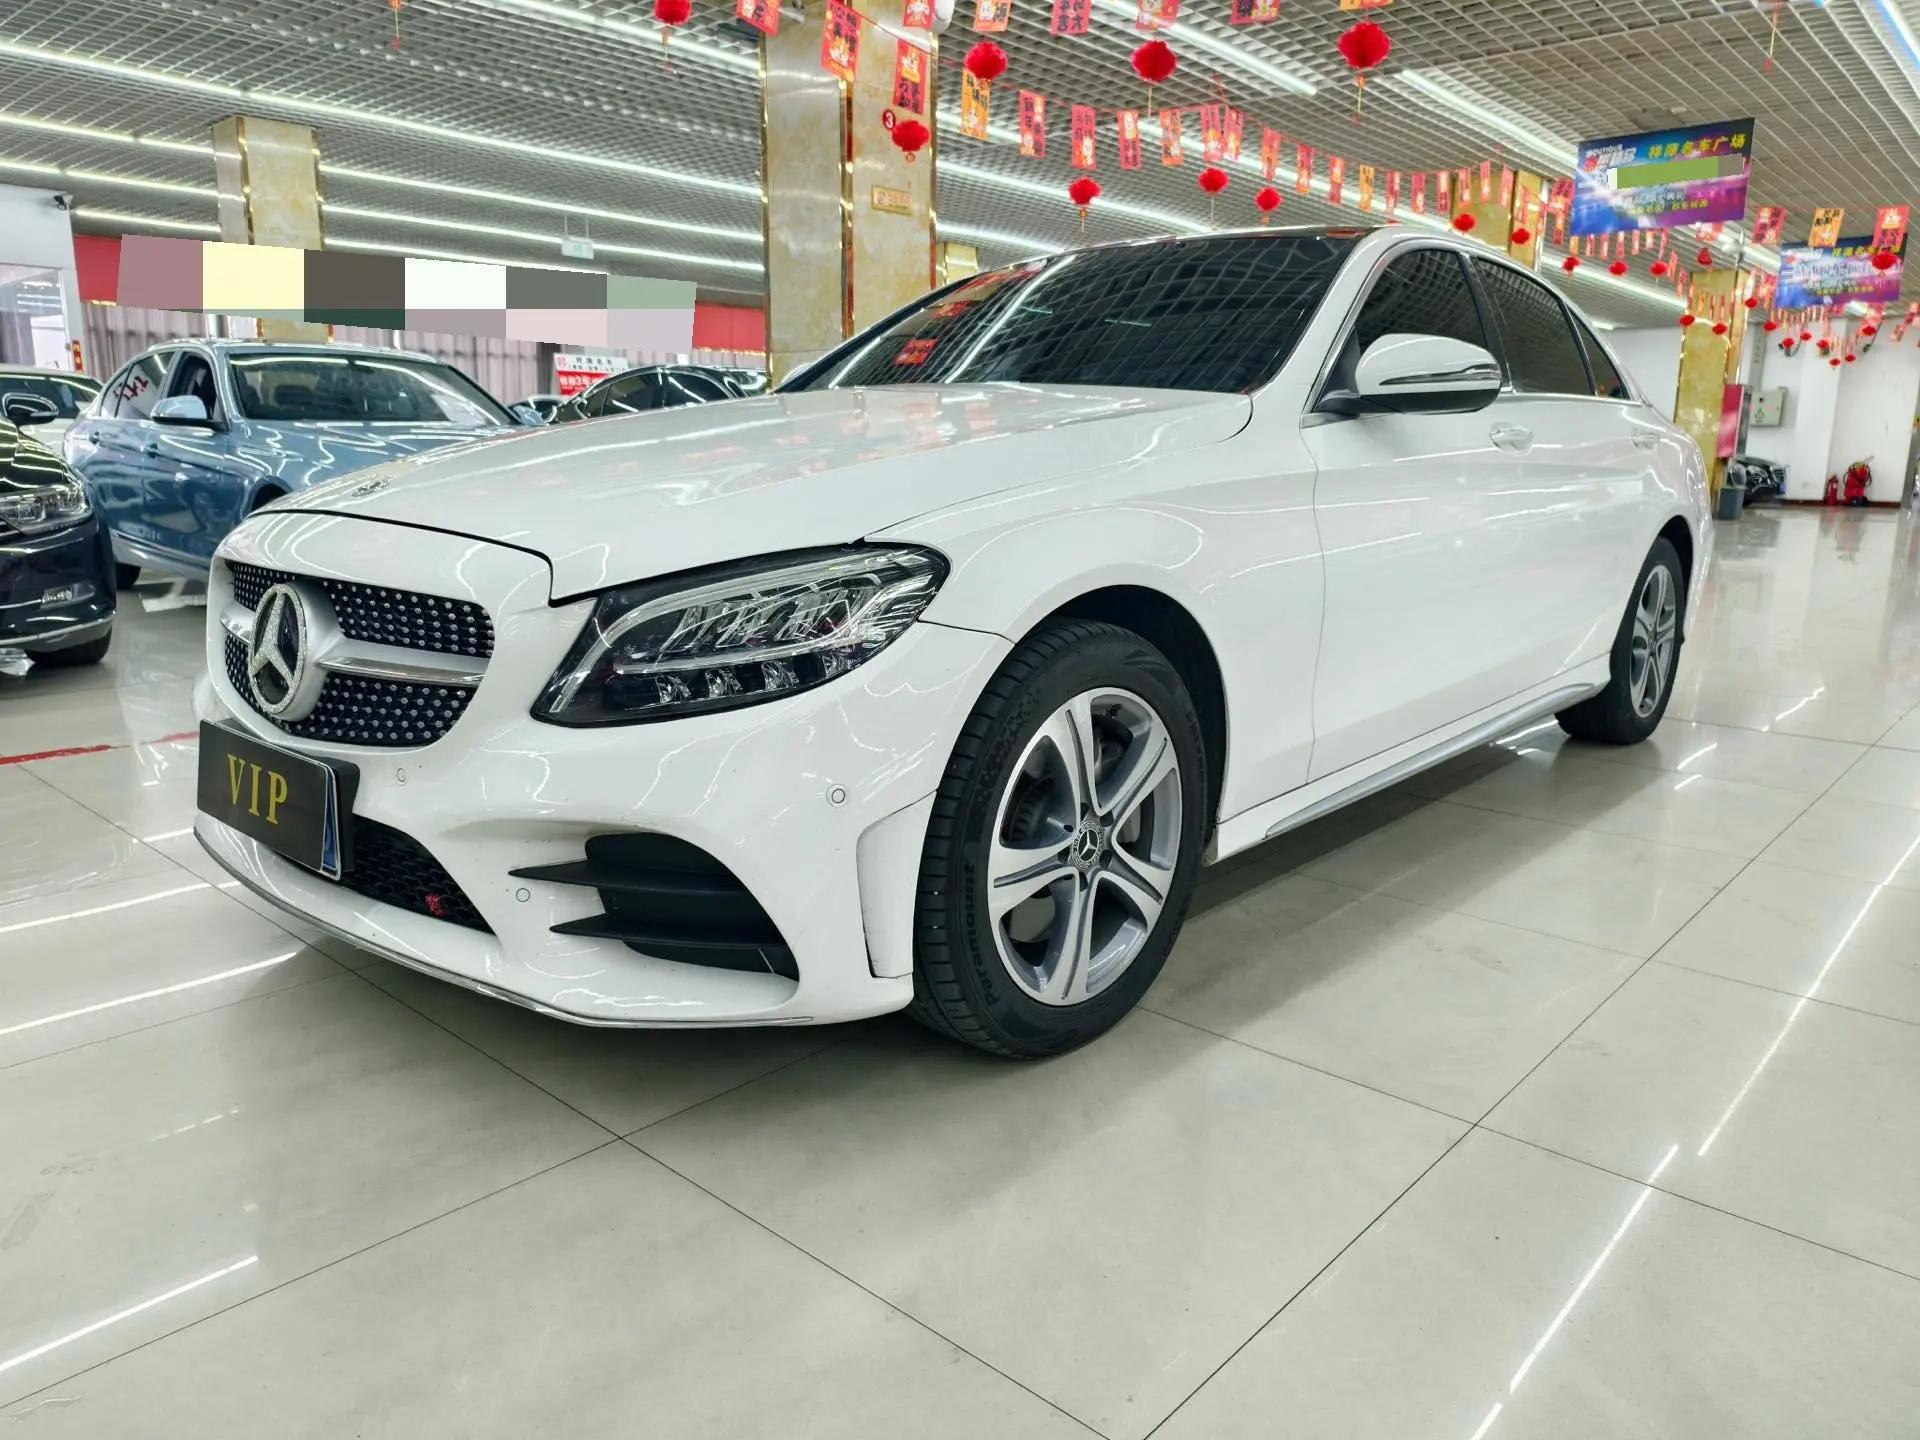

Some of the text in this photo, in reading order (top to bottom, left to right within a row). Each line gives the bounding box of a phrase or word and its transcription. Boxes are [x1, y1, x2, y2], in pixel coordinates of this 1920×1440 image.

[885, 111, 894, 129] 3
[228, 754, 287, 824] VIP
[965, 859, 999, 1006] Paramount
